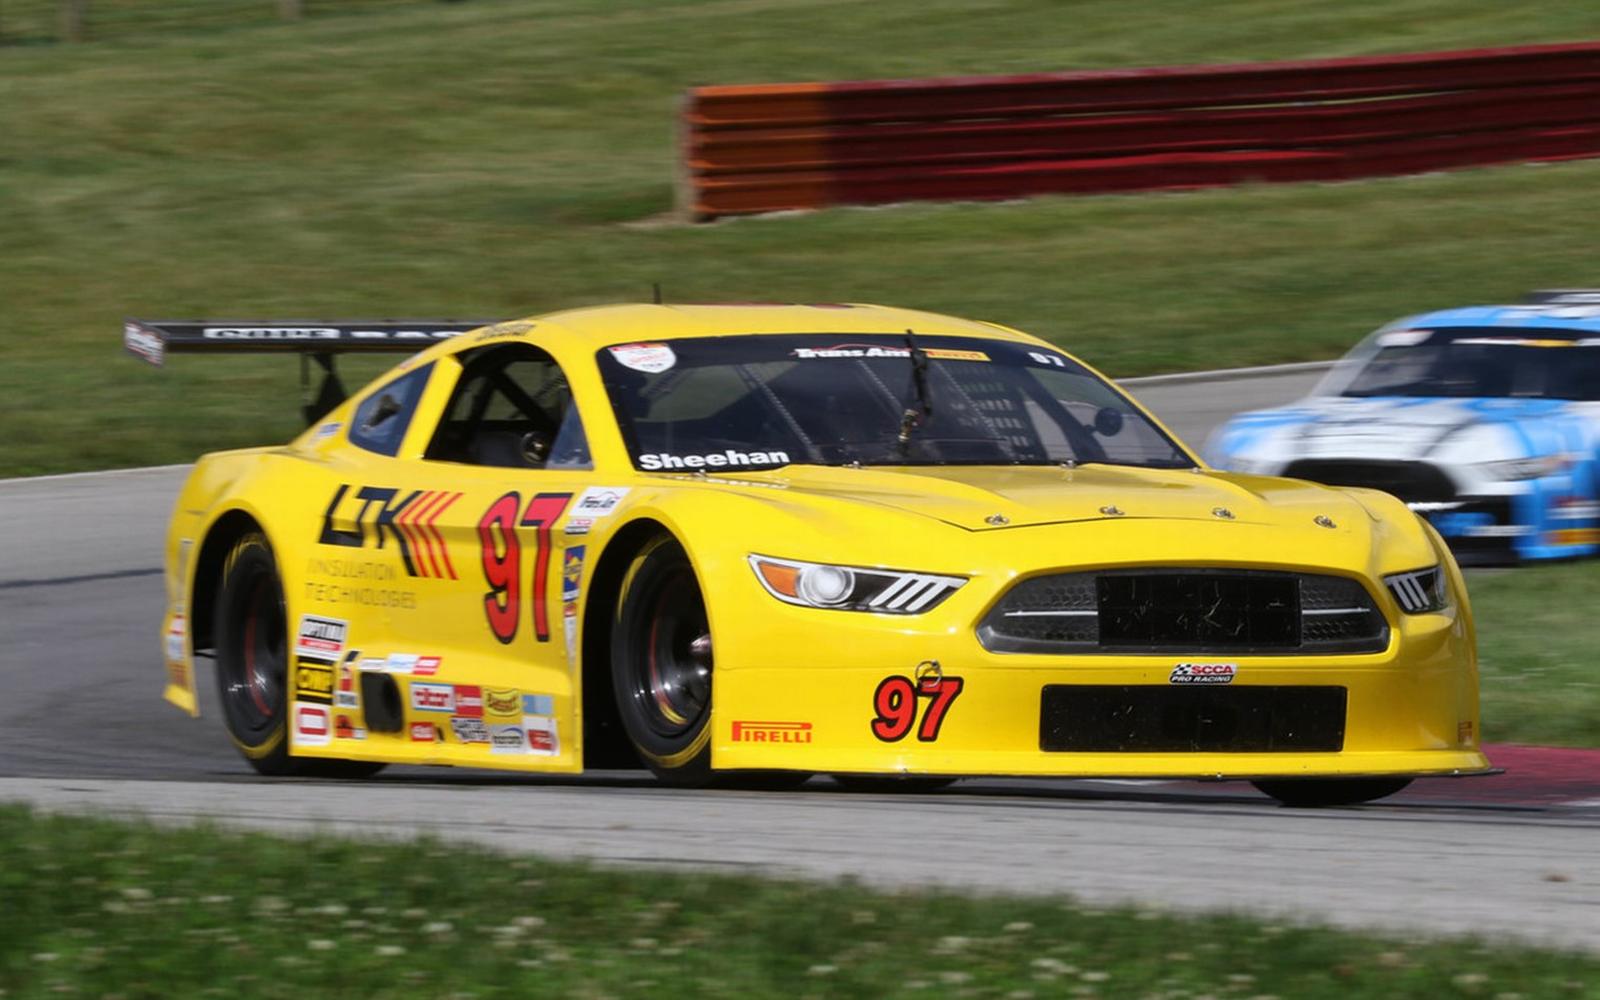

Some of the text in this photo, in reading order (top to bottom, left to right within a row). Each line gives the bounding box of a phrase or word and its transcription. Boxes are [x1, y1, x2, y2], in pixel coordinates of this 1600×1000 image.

[1028, 351, 1066, 367] 97
[639, 450, 790, 470] Sheehan
[318, 484, 425, 578] LTK
[477, 490, 574, 645] 97
[304, 582, 417, 610] TECHNOLOGIES
[1191, 665, 1233, 674] SCCA
[870, 675, 965, 743] 97
[731, 720, 813, 744] PIRELLI
